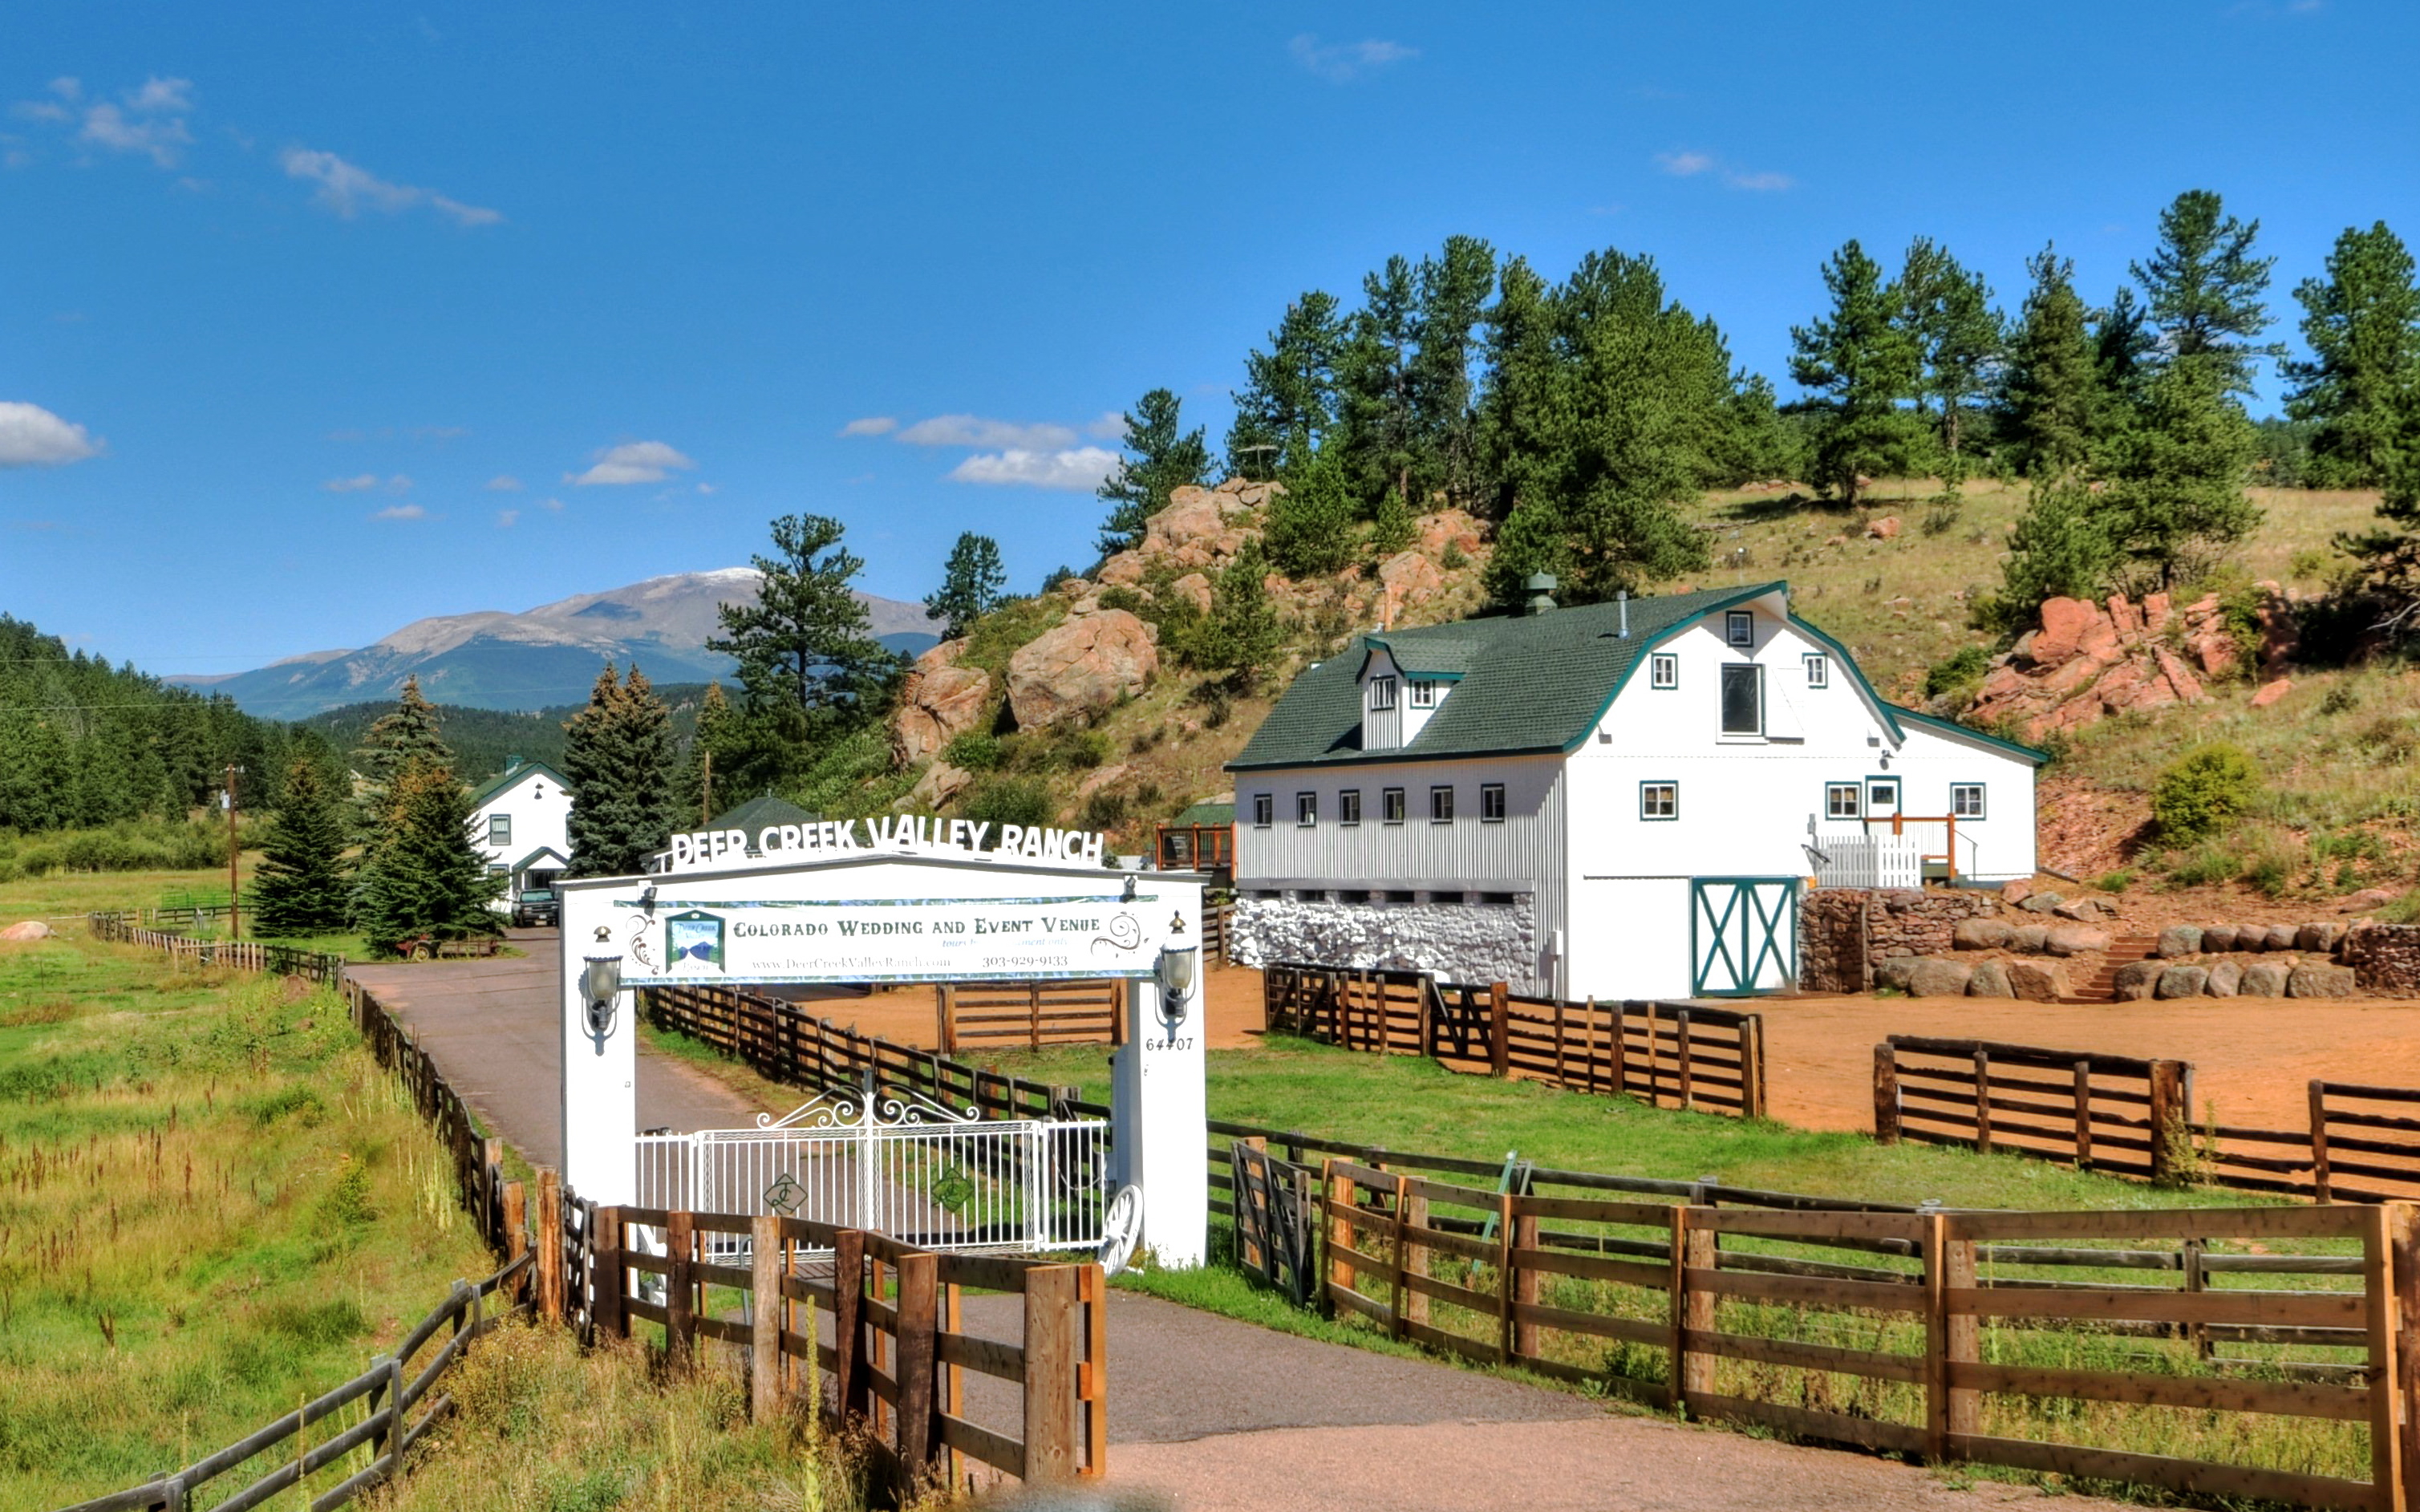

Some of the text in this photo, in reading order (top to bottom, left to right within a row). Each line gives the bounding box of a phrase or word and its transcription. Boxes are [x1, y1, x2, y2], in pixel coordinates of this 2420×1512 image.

[671, 813, 1105, 869] DEER CREEK VALLEY RANCH
[733, 922, 829, 938] COLORADO
[837, 920, 923, 937] WEDDING
[974, 918, 1034, 934] EVENT
[1041, 917, 1101, 933] VENUE
[982, 956, 1068, 968] 303-929-9133
